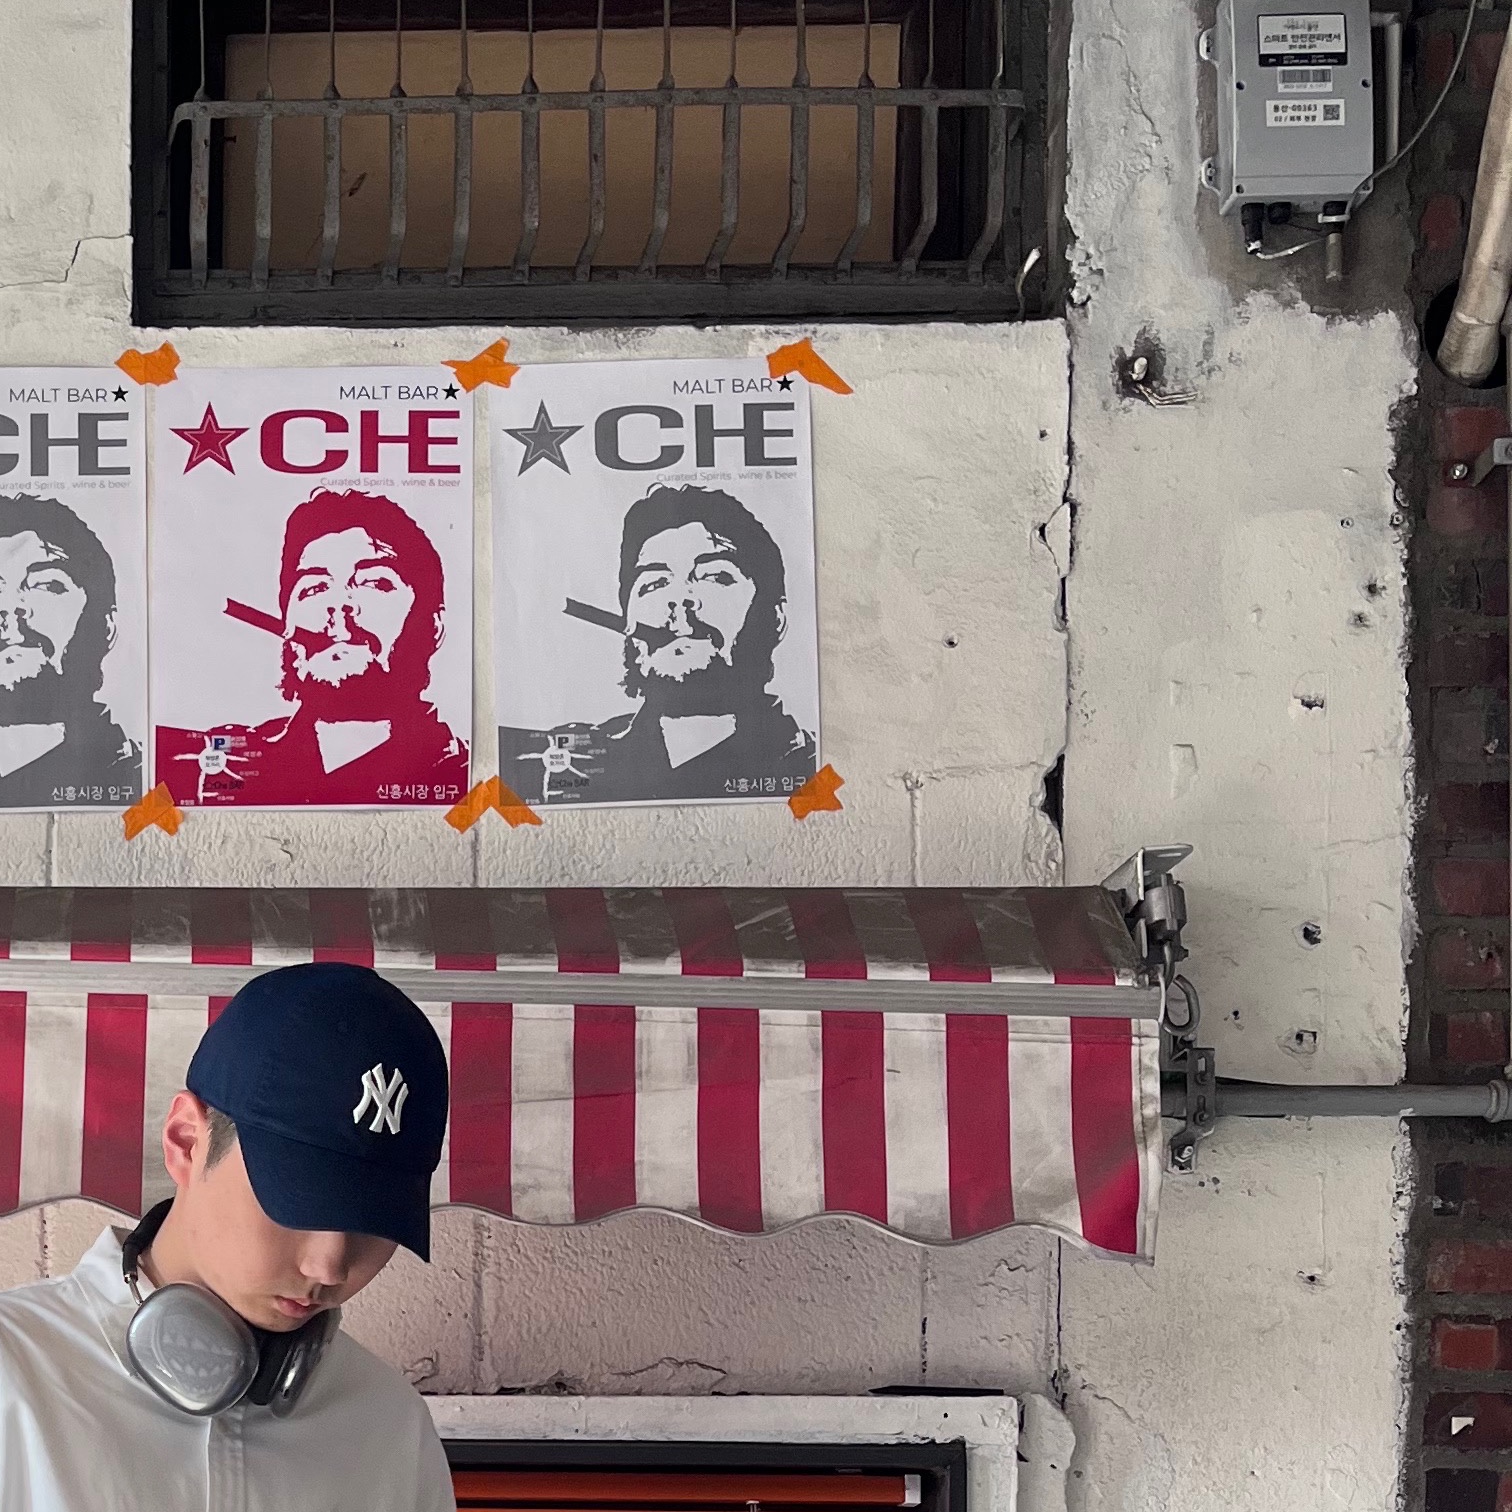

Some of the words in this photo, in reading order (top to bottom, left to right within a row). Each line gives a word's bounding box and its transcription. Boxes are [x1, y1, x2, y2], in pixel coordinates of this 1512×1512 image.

[340, 385, 392, 400] MALT
[398, 385, 438, 400] BAR
[673, 379, 726, 395] MALT
[732, 378, 772, 393] BAR
[9, 388, 61, 403] MALT
[68, 388, 107, 403] BAR
[260, 409, 461, 474] CHE
[595, 402, 798, 471] CHE
[320, 478, 360, 487] Curated
[402, 479, 426, 487] wine
[438, 479, 461, 487] beer
[656, 472, 697, 481] Curated
[738, 472, 762, 480] wine
[774, 471, 797, 479] beer
[72, 481, 96, 489] wine
[107, 480, 131, 488] beer
[376, 784, 429, 800] 신흥시장
[433, 784, 460, 800] 입구
[724, 777, 776, 793] 신흥시장
[52, 786, 104, 801] 신흥시장
[108, 786, 135, 801] 입구
[353, 1062, 409, 1135] NY
